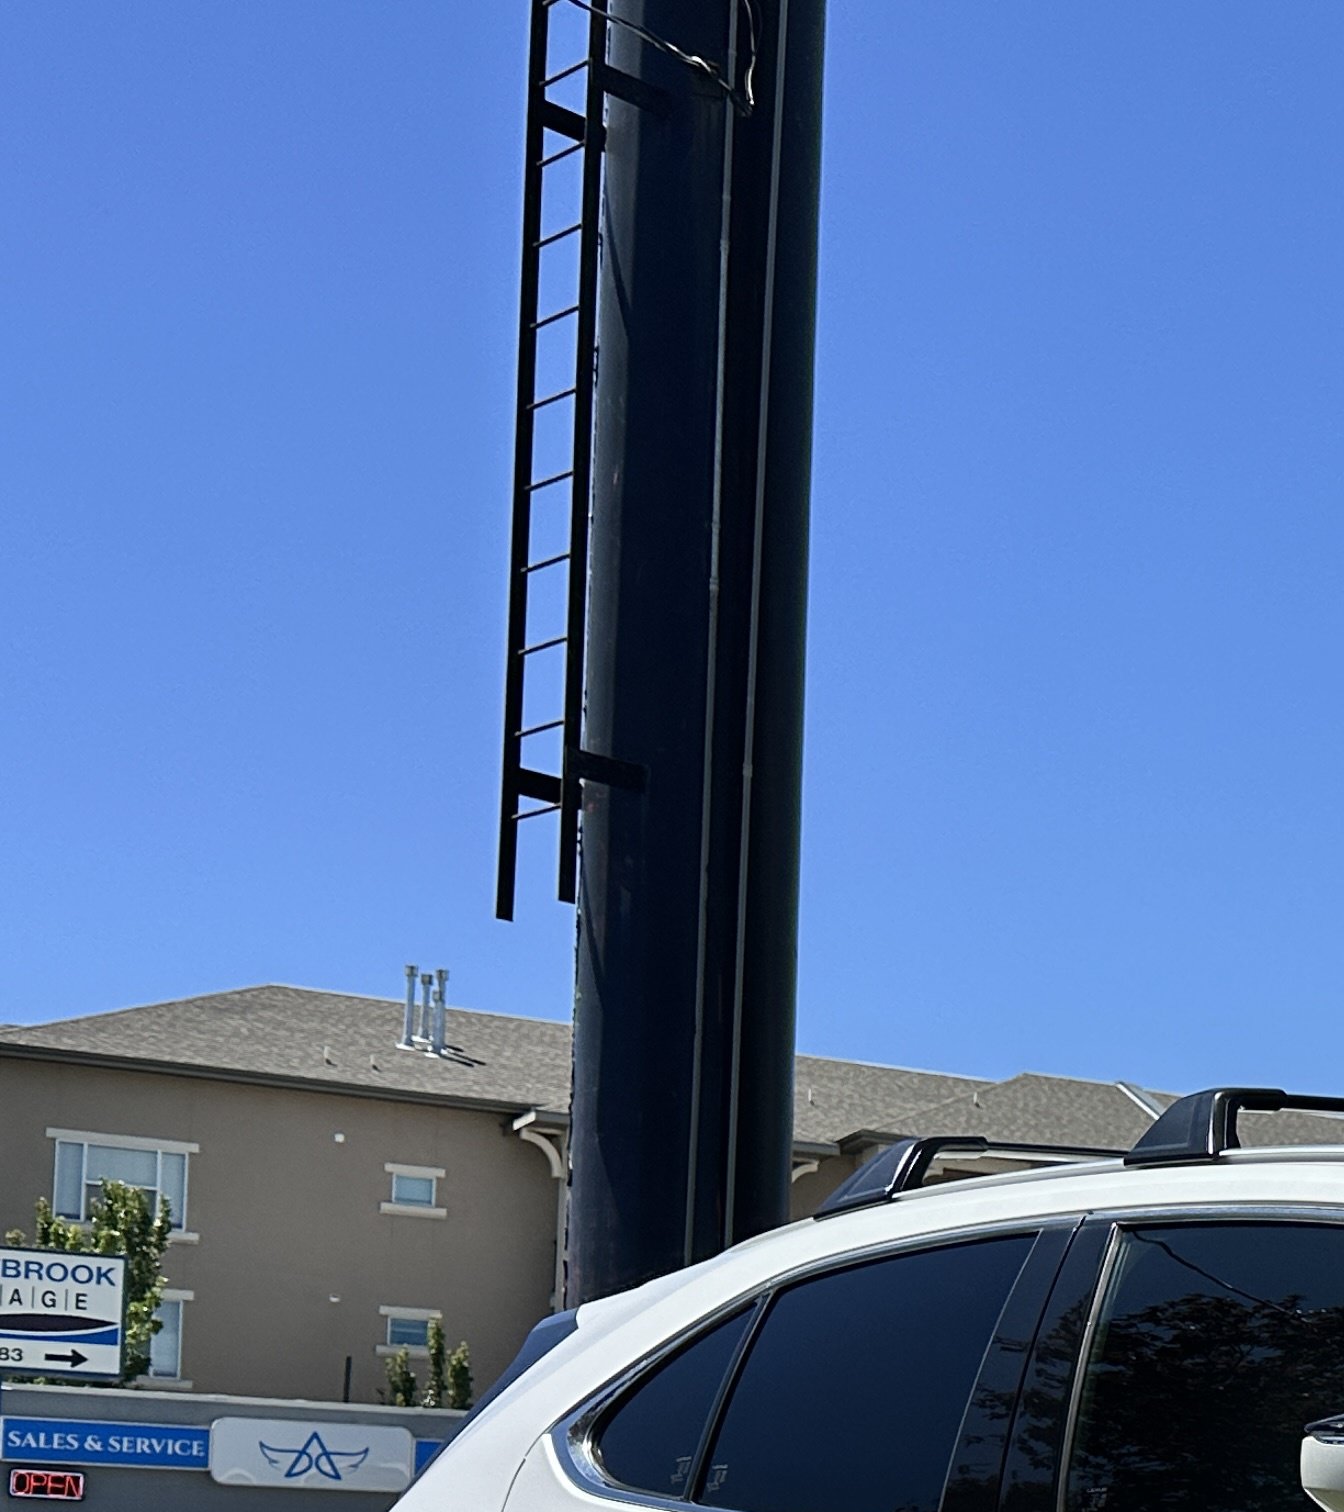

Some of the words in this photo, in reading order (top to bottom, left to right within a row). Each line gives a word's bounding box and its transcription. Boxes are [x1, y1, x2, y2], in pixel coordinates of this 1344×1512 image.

[7, 1430, 79, 1450] SALES
[84, 1434, 103, 1451] &
[107, 1435, 206, 1457] SERVICE
[13, 1471, 81, 1498] OPEN
